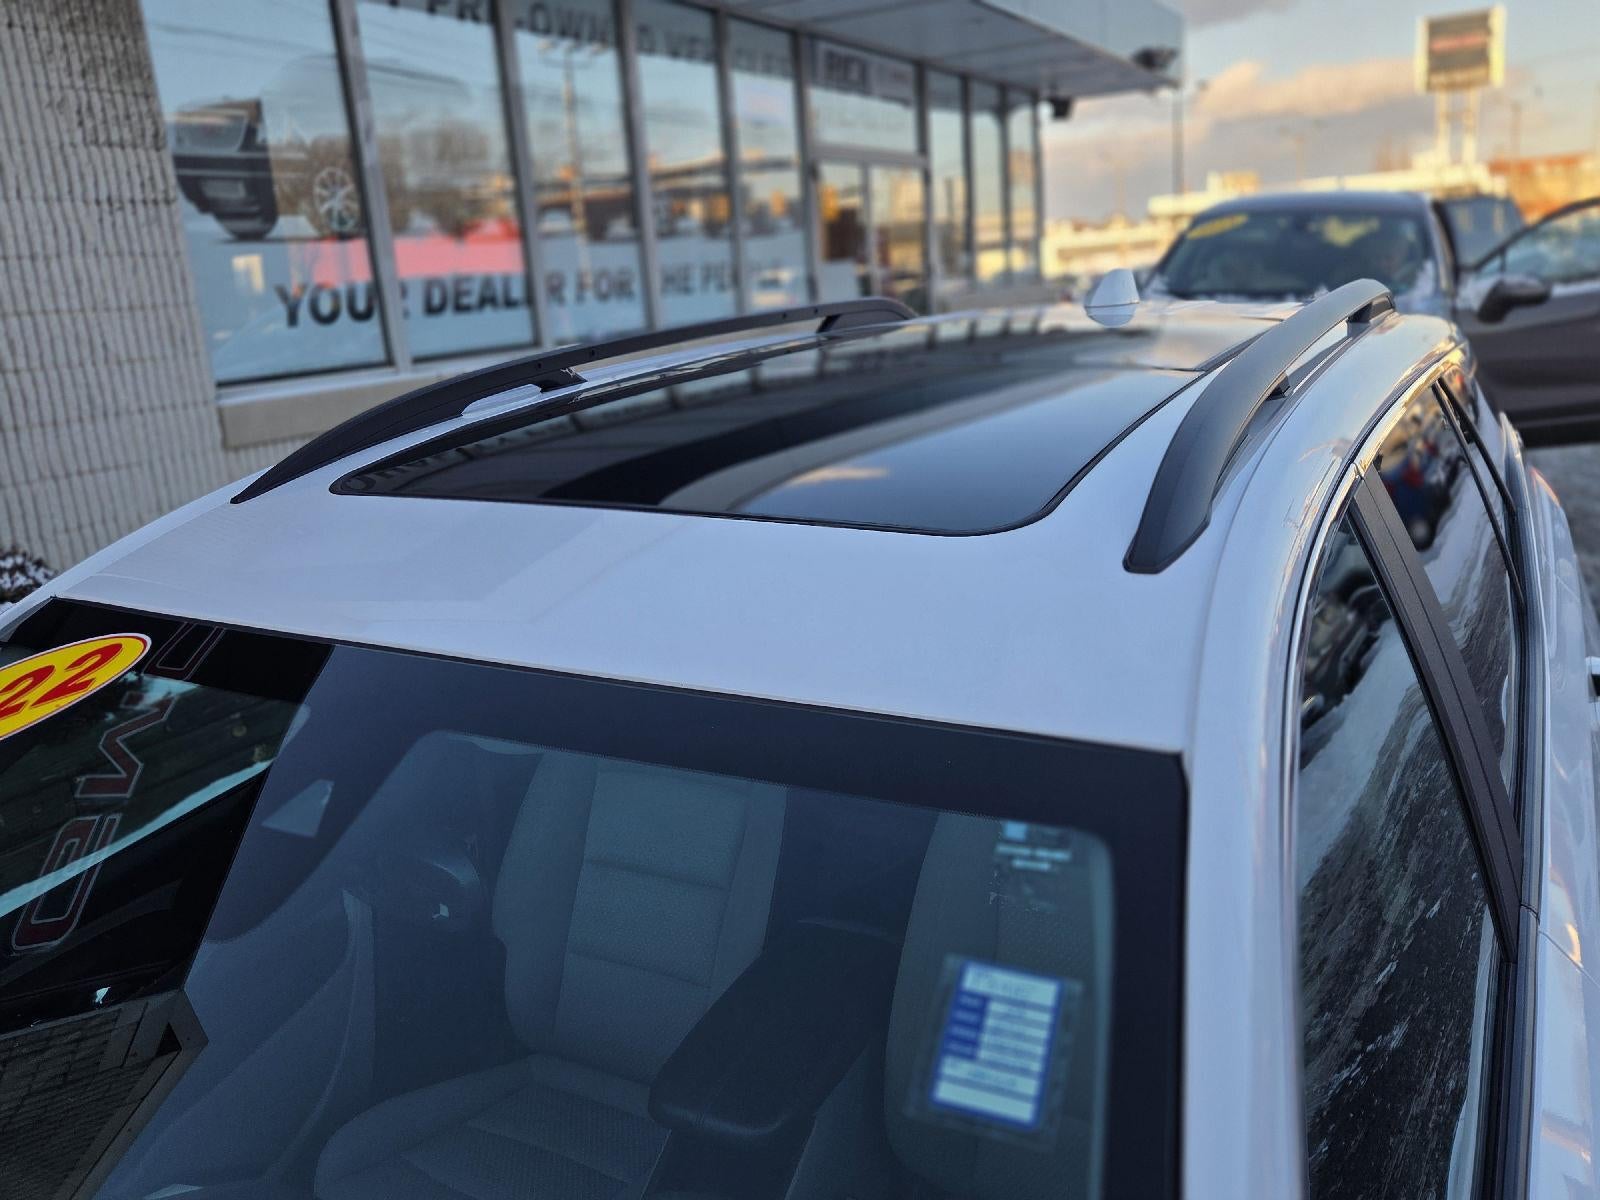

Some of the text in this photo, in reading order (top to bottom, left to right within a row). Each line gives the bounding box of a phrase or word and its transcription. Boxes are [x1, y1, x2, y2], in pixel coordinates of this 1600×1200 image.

[426, 0, 655, 54] R-OWND
[424, 271, 566, 316] DEALR
[575, 266, 635, 304] FOR
[656, 262, 695, 298] HE
